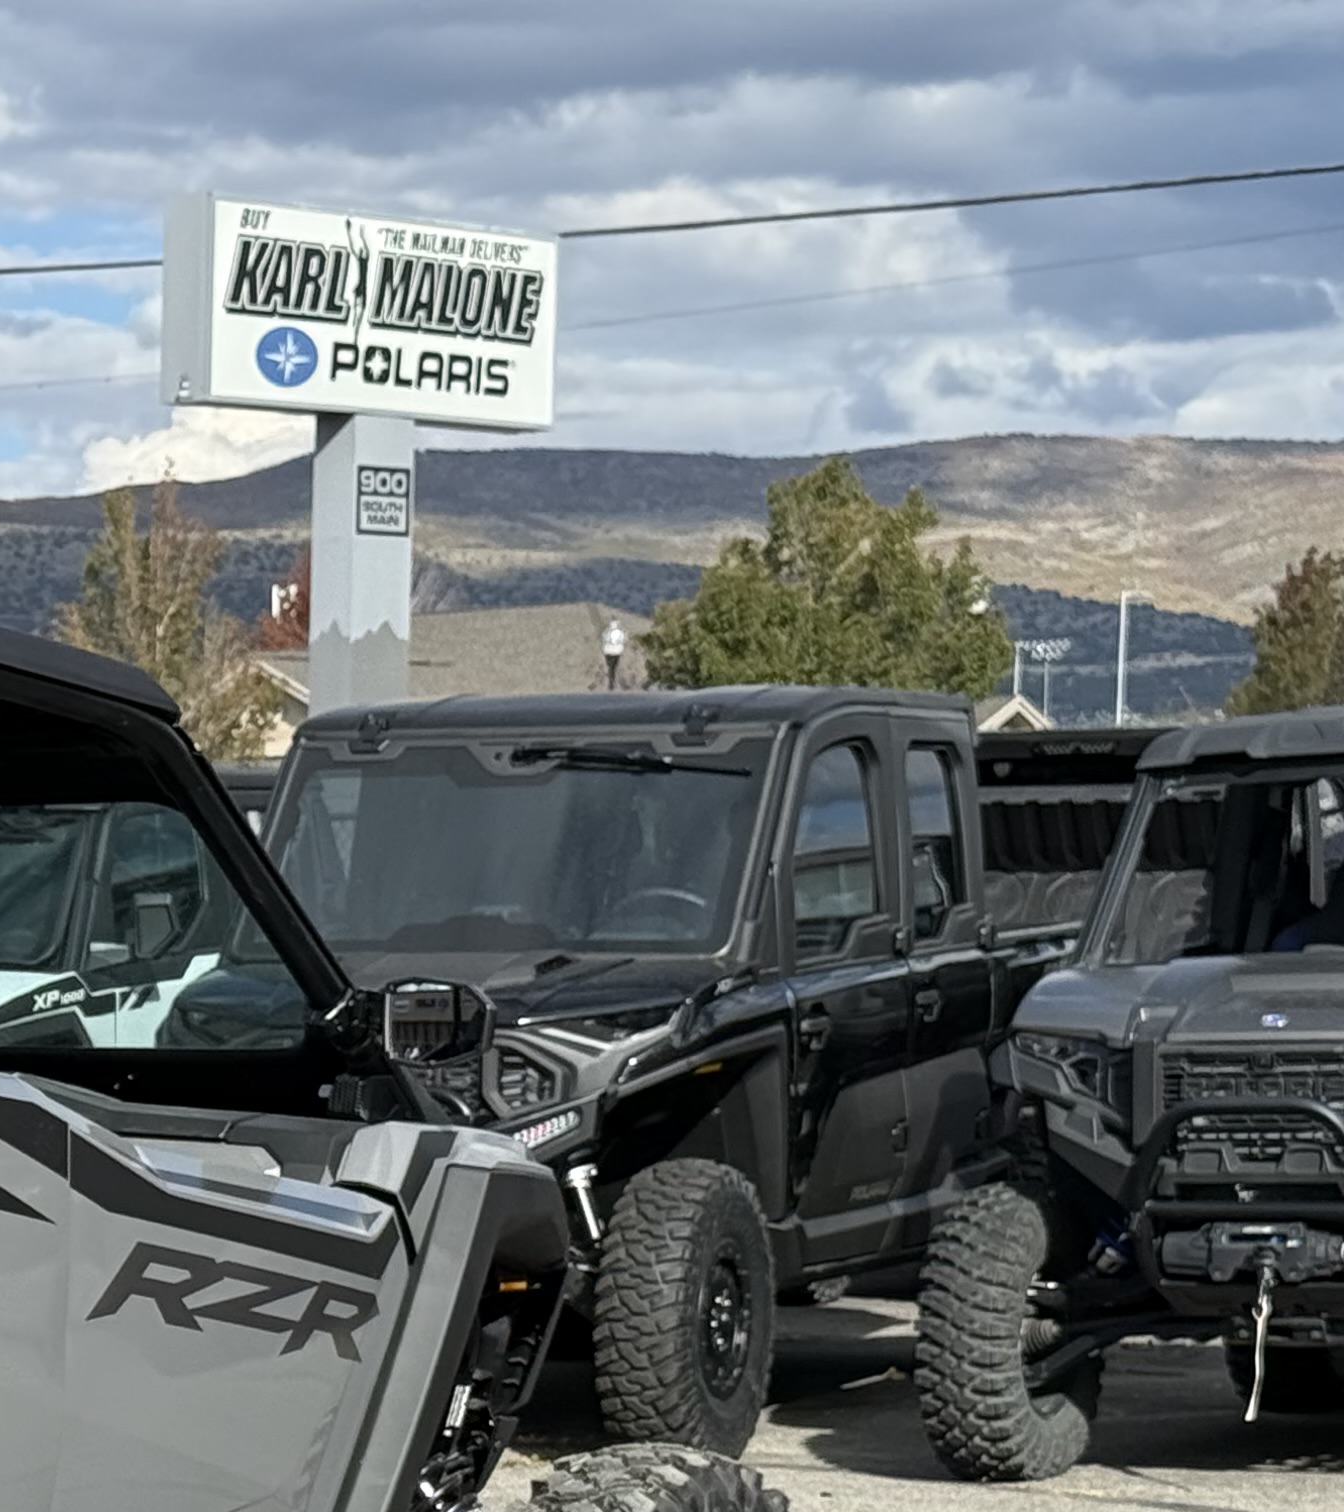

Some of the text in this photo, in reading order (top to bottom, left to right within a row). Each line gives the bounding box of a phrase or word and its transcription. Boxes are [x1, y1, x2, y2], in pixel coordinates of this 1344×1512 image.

[239, 208, 271, 231] BUY
[223, 233, 544, 347] KARL MALONE
[330, 341, 510, 398] POLARIS
[360, 470, 407, 495] 900
[32, 989, 61, 1013] XP
[84, 1240, 380, 1364] RZR
